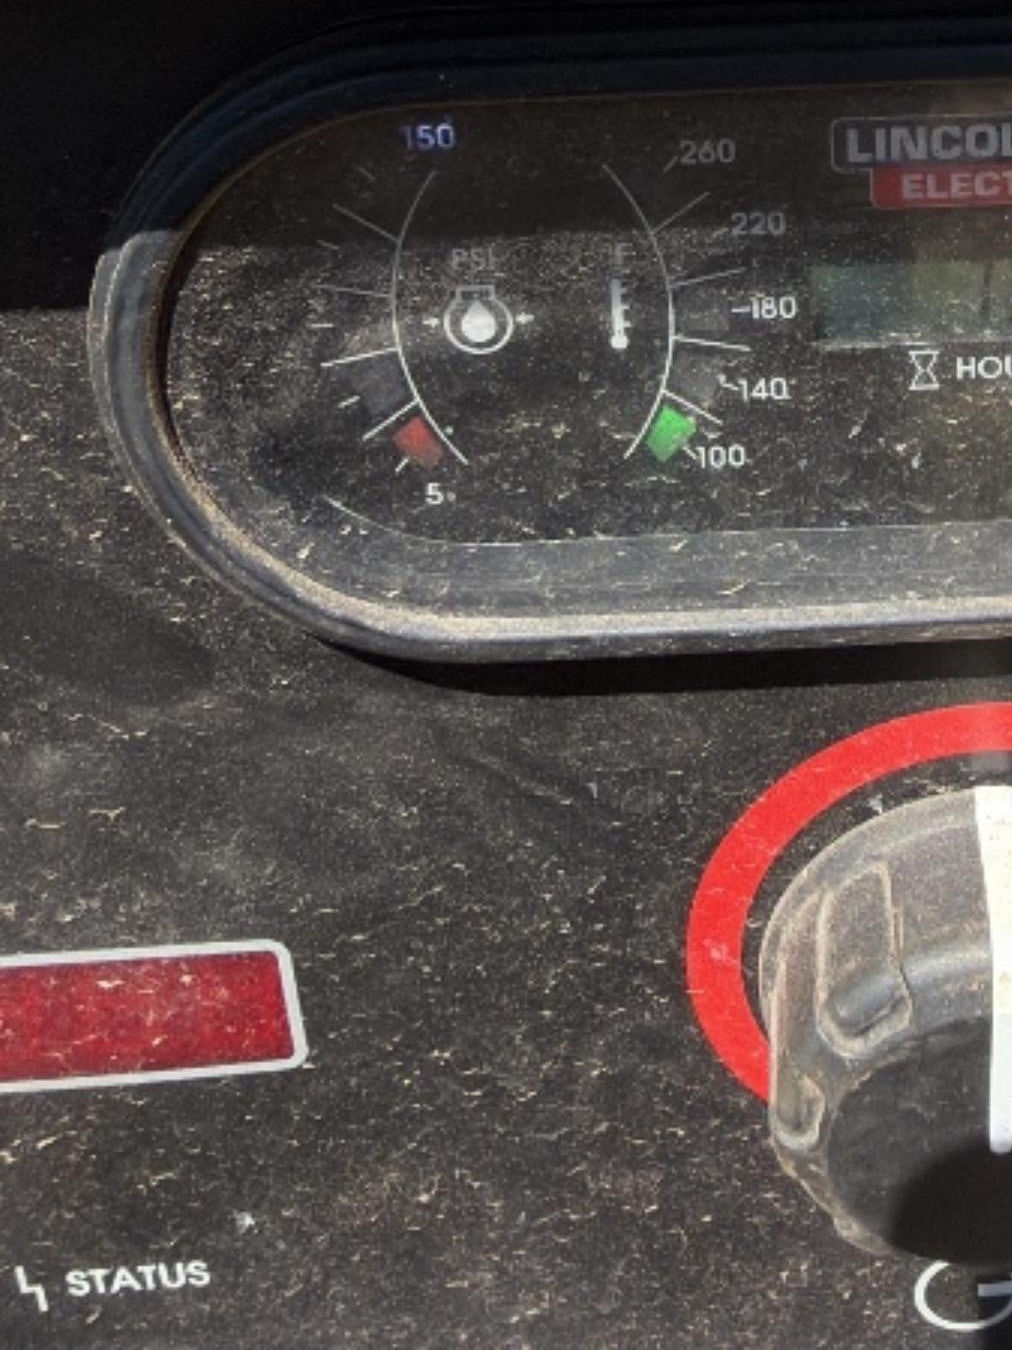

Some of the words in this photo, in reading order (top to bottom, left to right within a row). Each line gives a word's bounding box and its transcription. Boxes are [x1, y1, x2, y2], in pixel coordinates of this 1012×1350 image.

[403, 123, 456, 149] 150
[679, 139, 736, 165] 260
[730, 211, 787, 237] 220
[750, 296, 797, 321] 180
[738, 378, 789, 403] 140
[697, 445, 746, 469] 100
[424, 482, 444, 507] 5
[65, 1259, 211, 1298] STATUS
